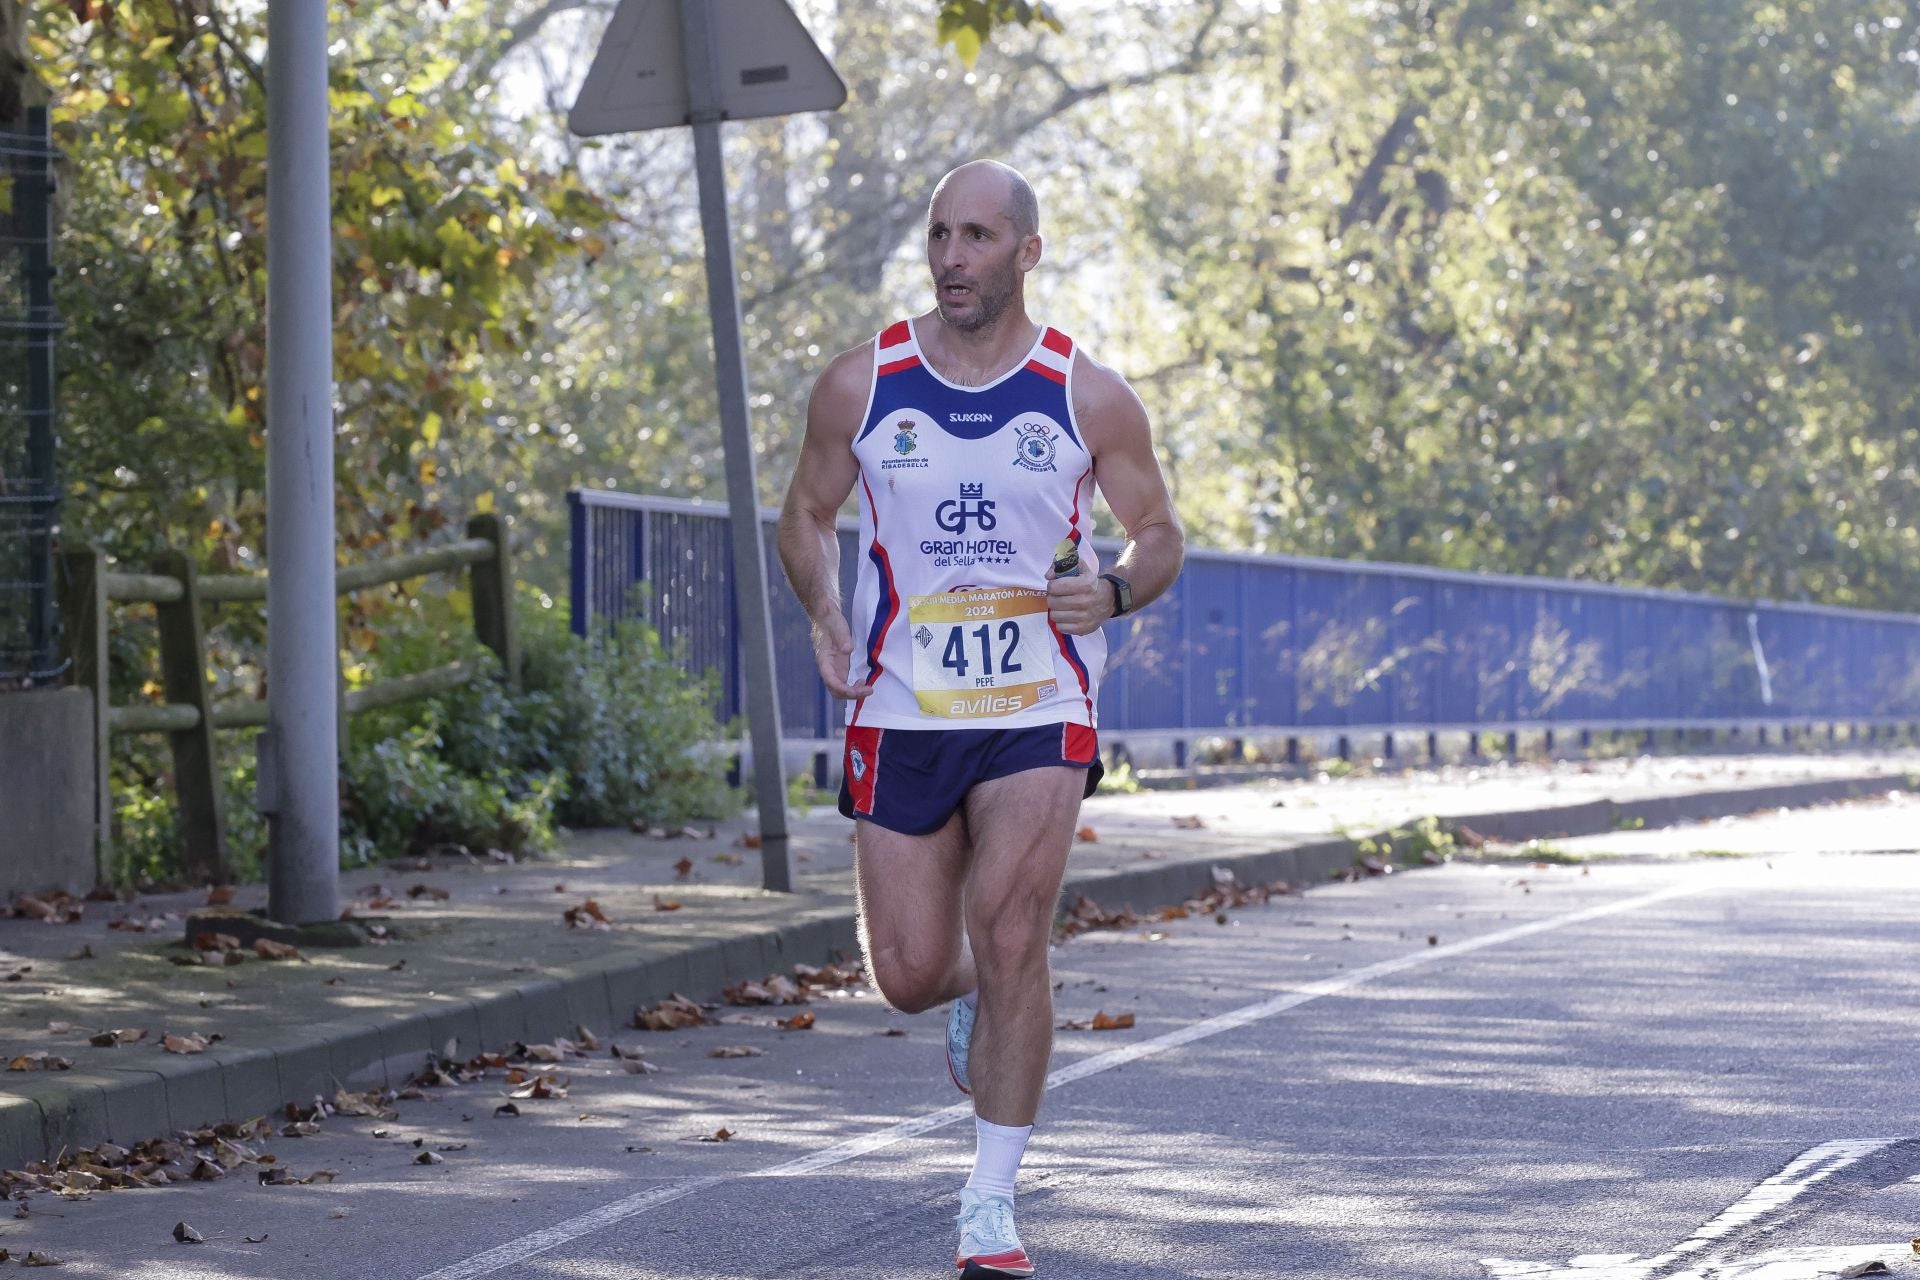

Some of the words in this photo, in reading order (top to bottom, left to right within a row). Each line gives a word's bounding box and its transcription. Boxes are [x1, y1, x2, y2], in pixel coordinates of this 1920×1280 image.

[949, 412, 993, 422] SUKAN
[881, 462, 929, 470] RIBADESELLA
[934, 556, 952, 567] del
[953, 555, 975, 567] Sella
[939, 595, 967, 605] MEDIA
[968, 589, 1015, 603] MARATÓN
[964, 605, 996, 618] 2024
[942, 620, 1022, 677] 412
[975, 677, 995, 688] PEPE
